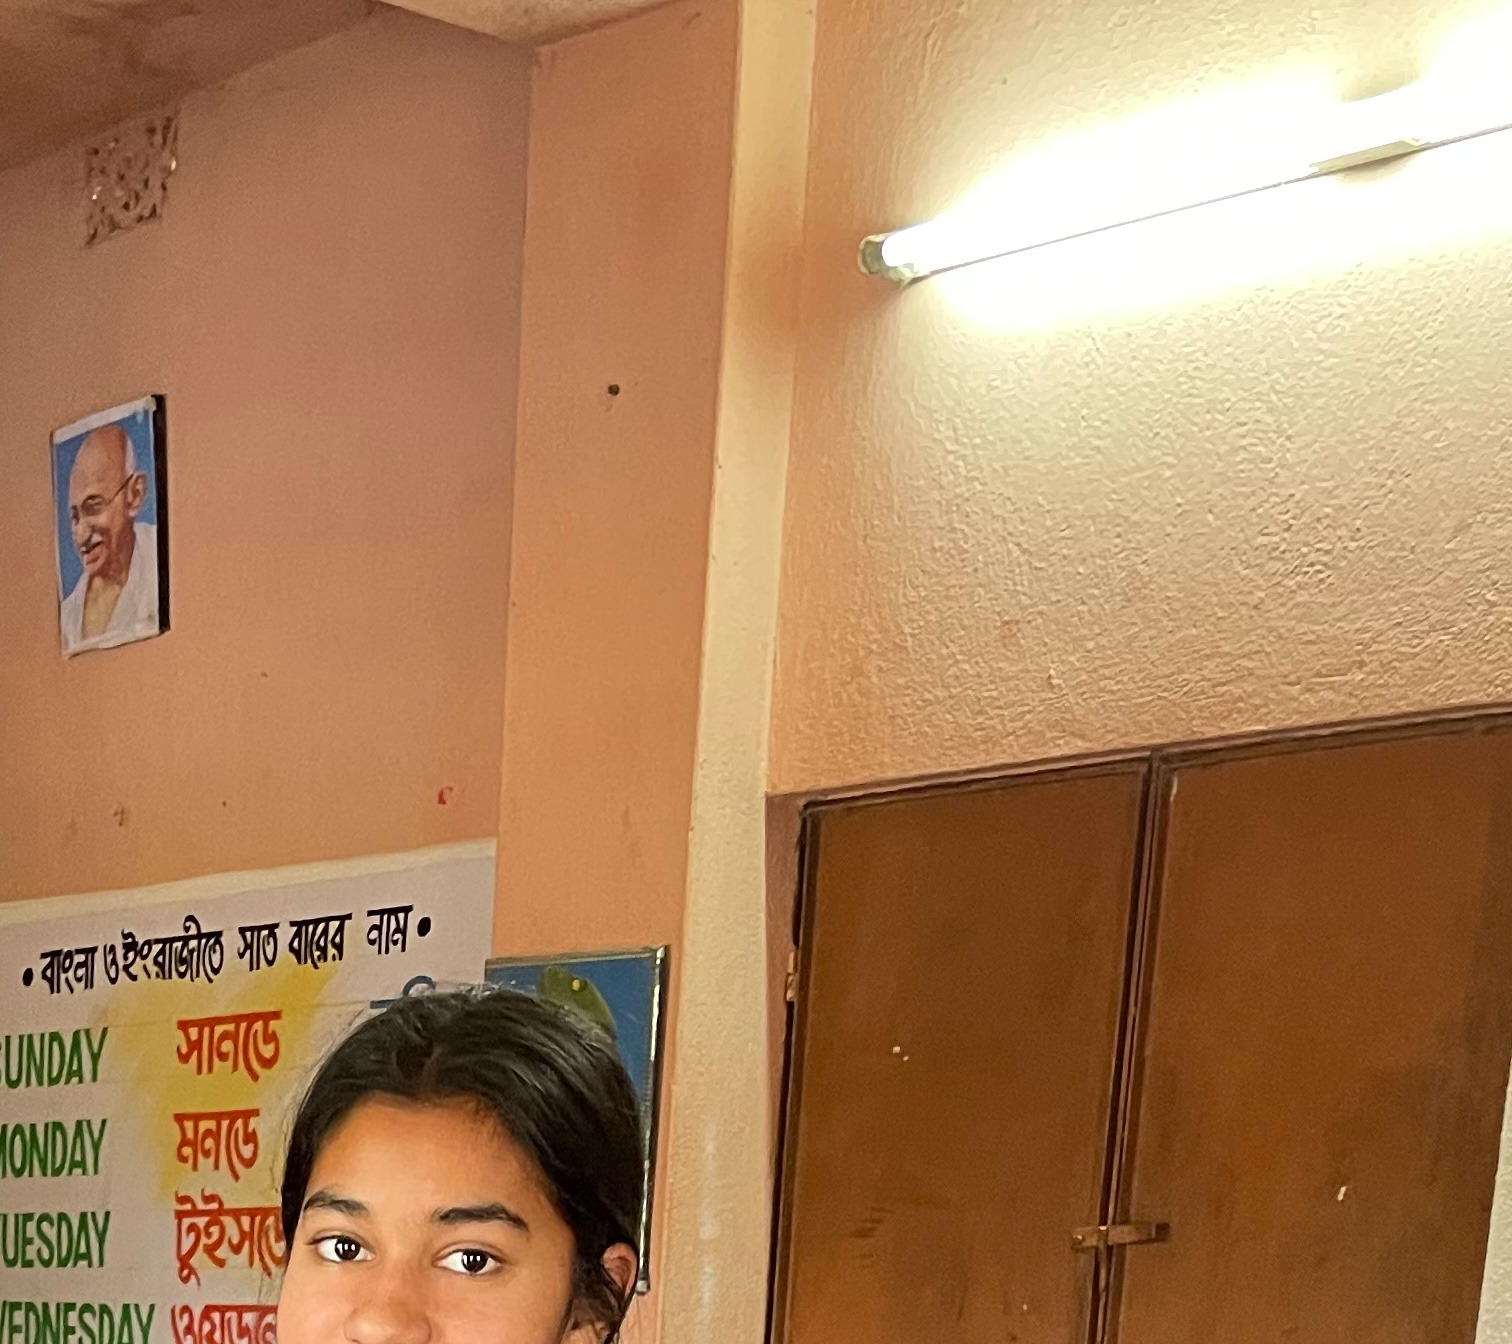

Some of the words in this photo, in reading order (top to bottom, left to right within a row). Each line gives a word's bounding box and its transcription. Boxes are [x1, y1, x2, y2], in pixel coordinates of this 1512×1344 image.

[40, 945, 98, 994] বাংলা
[237, 922, 280, 972] সাত
[288, 913, 352, 969] বারের
[367, 904, 414, 955] নাম
[176, 1010, 282, 1083] সানডে
[173, 1108, 260, 1182] মনডে
